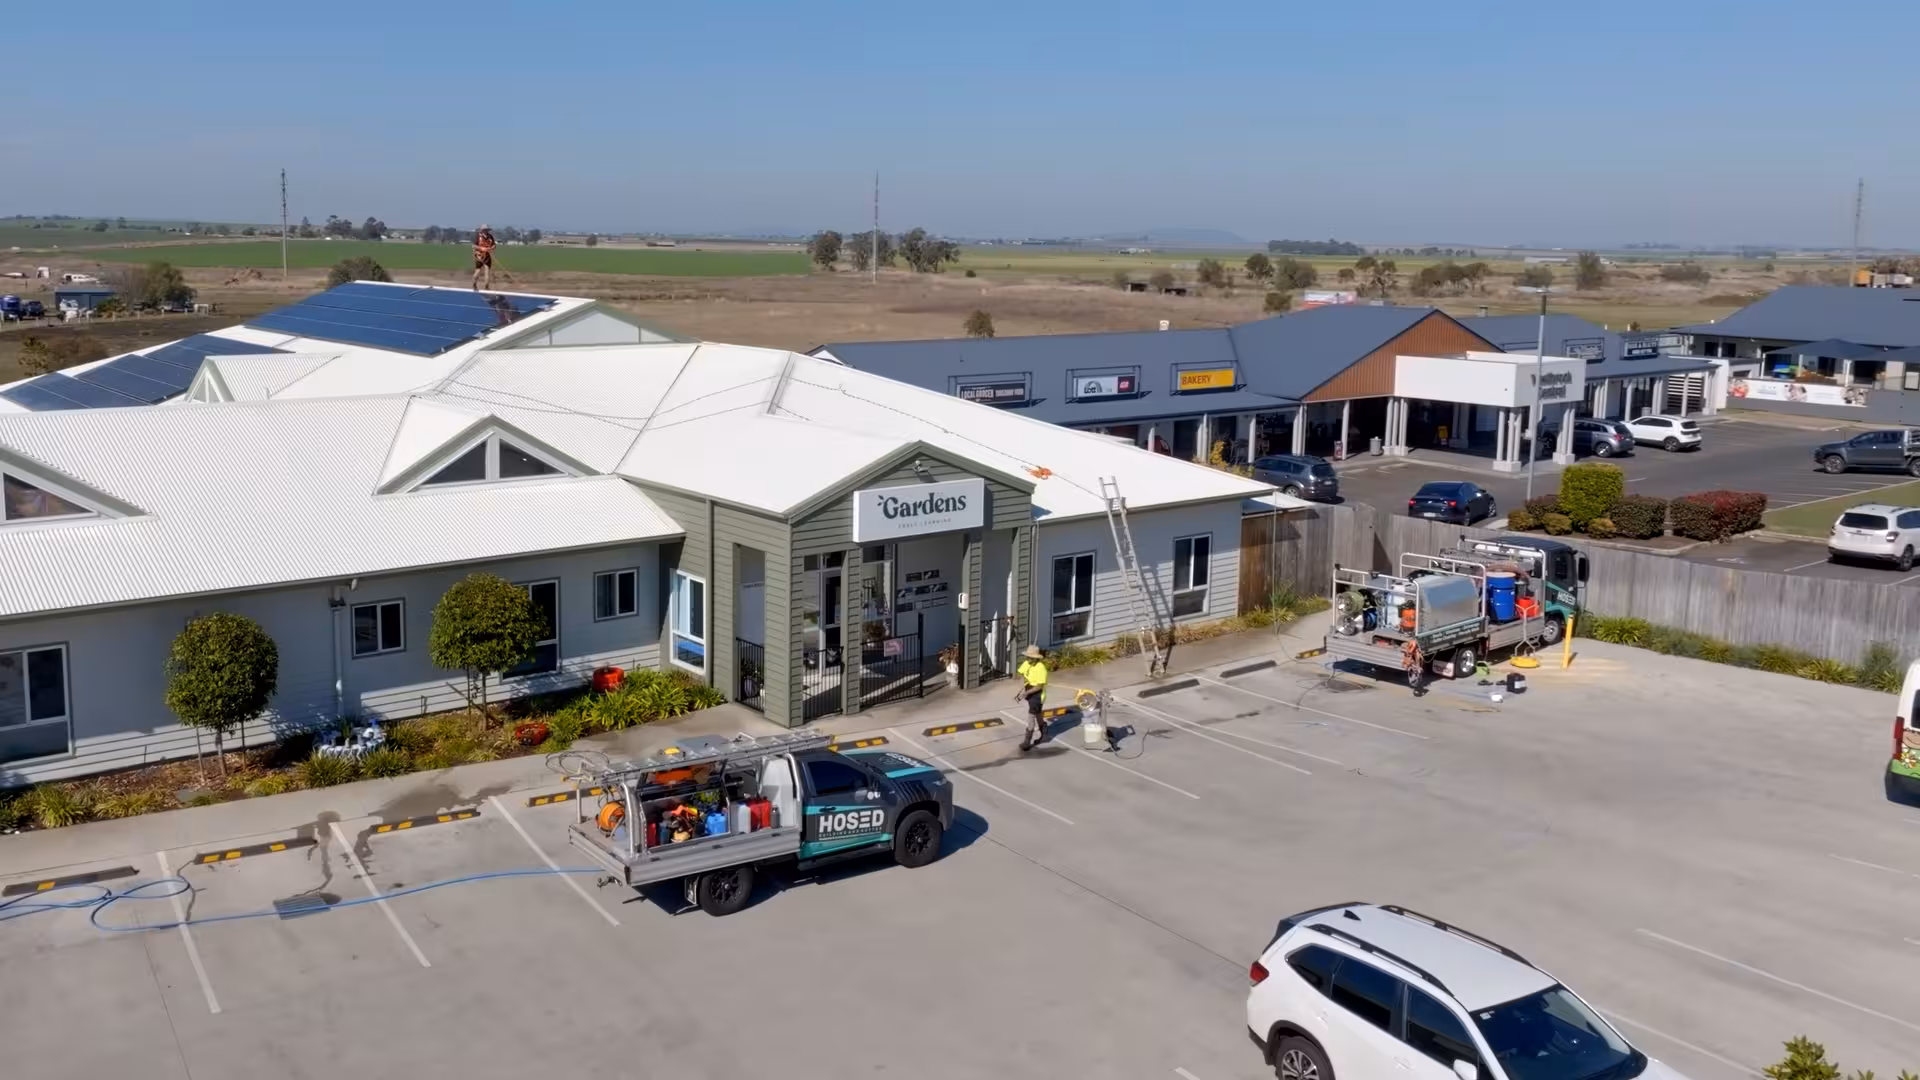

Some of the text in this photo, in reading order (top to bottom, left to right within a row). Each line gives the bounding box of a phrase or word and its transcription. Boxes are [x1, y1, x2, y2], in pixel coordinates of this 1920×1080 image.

[1182, 374, 1211, 385] BAKERY
[961, 389, 976, 400] LOCAL
[976, 388, 994, 399] GROCER
[880, 492, 967, 520] Gardens
[920, 517, 952, 527] LEARNING
[819, 809, 885, 833] HOSED
[818, 830, 848, 838] BUILDING
